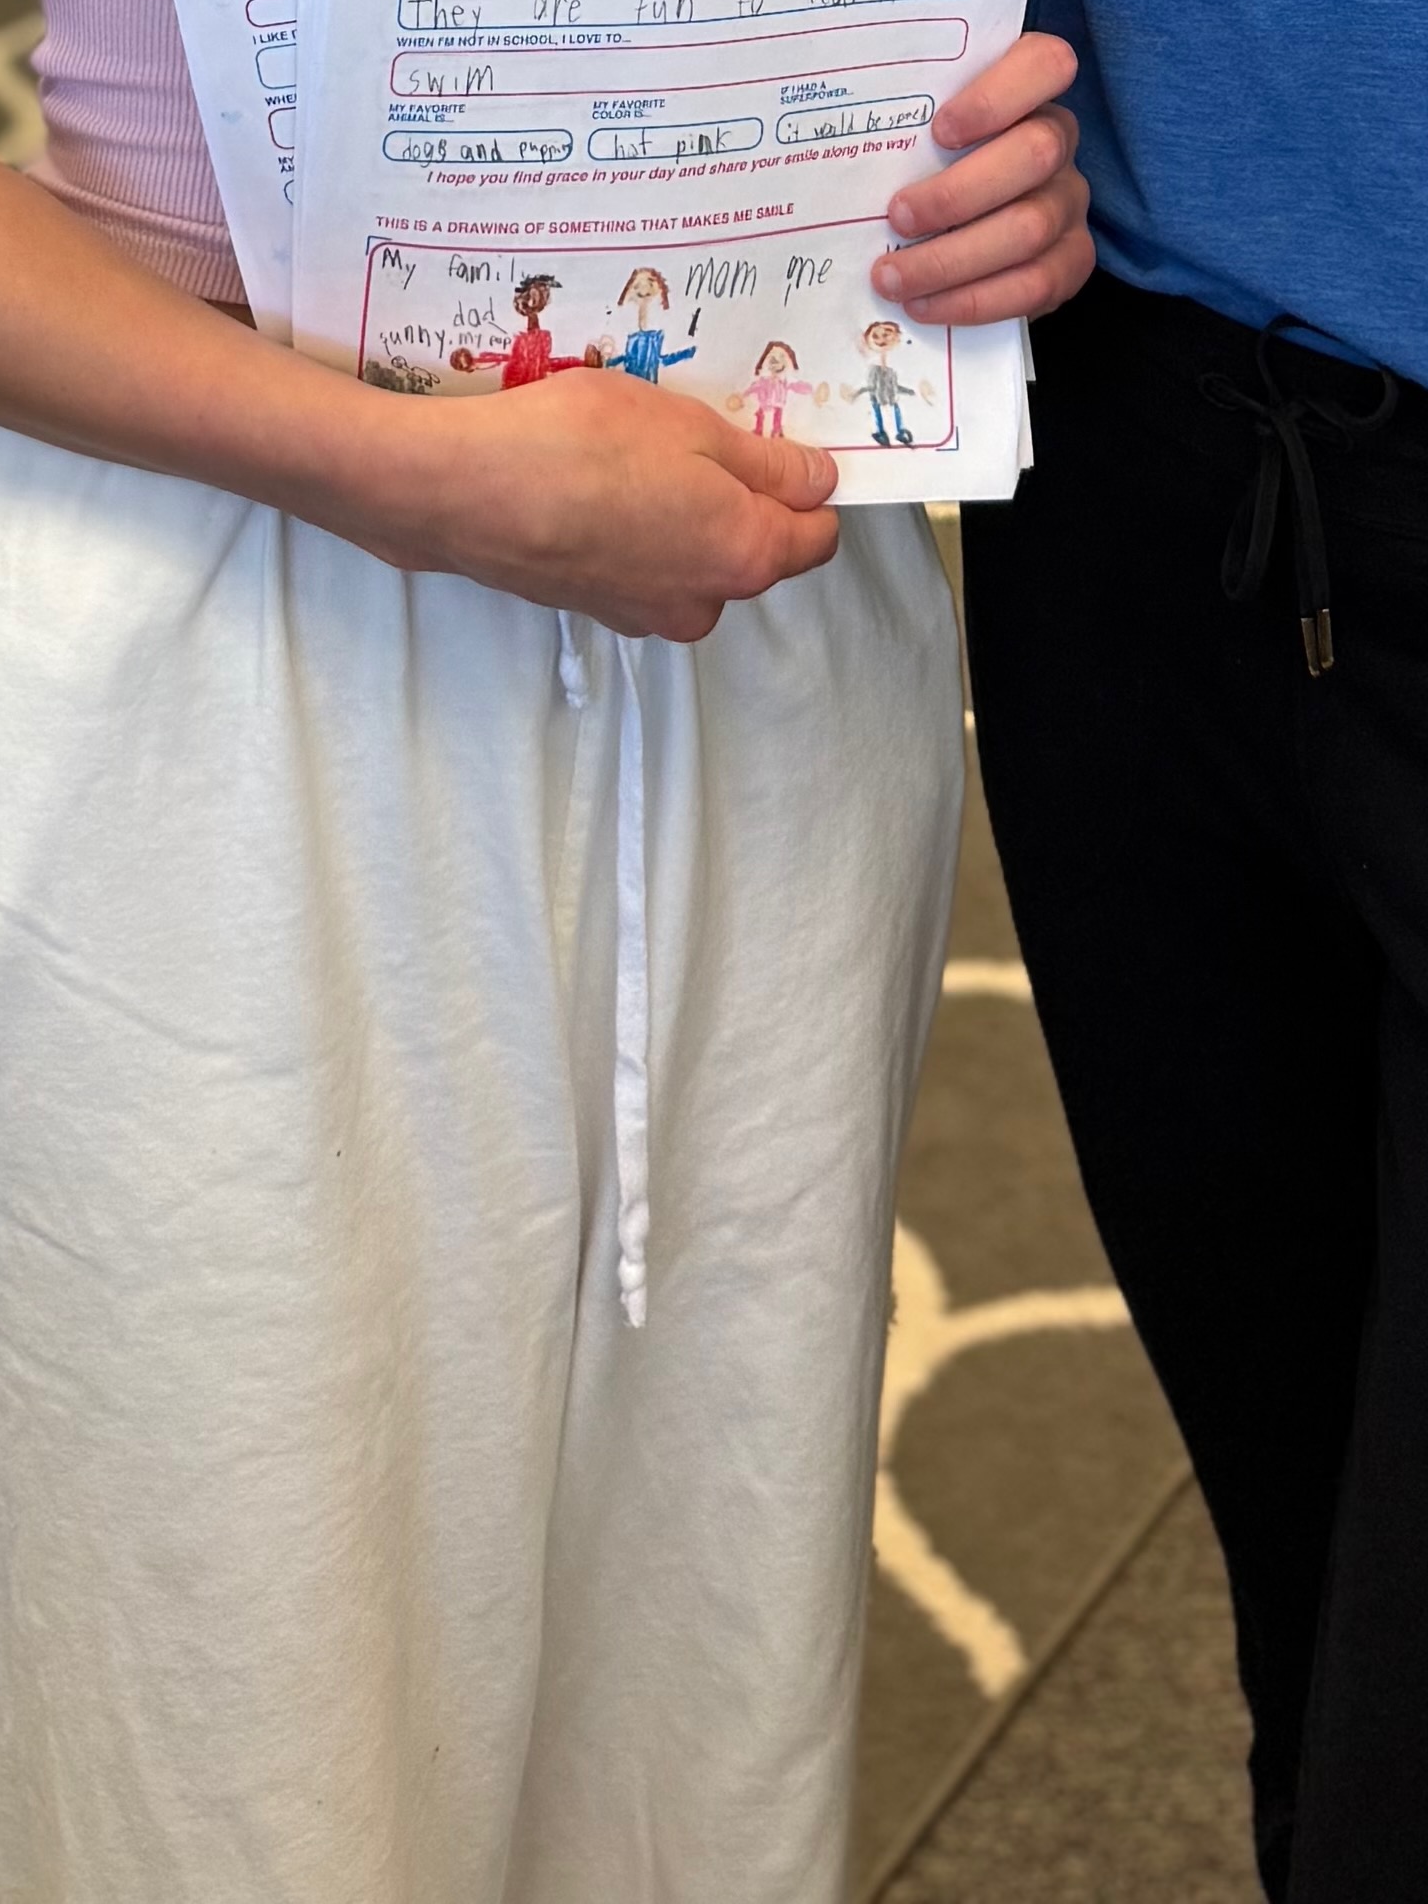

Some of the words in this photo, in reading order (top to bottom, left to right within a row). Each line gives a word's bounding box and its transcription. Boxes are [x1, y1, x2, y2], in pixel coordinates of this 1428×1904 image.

[253, 35, 257, 45] I
[259, 30, 288, 44] LIKE
[396, 36, 434, 47] WHEN
[457, 35, 484, 47] NOT
[487, 35, 500, 46] IN
[503, 34, 559, 47] SCHOOL,
[569, 33, 602, 44] LOVE
[821, 81, 827, 90] A
[388, 104, 407, 114] MY
[409, 103, 466, 114] FAVORITE
[593, 100, 610, 110] MY
[612, 98, 666, 110] FAVORITE
[387, 113, 431, 123] ANIMAL
[592, 109, 631, 120] COLOR
[460, 138, 504, 163] and
[427, 172, 433, 183] I
[436, 170, 474, 187] hope
[479, 172, 509, 188] you
[512, 170, 543, 184] find
[545, 171, 589, 187] grace
[592, 169, 606, 181] in
[611, 170, 646, 185] your
[648, 167, 676, 183] day
[678, 163, 706, 178] and
[709, 159, 748, 176] share
[750, 155, 782, 173] your
[785, 148, 820, 165] smile
[822, 145, 860, 163] along
[862, 140, 883, 154] the
[885, 135, 918, 153] way!
[376, 215, 410, 230] THIS
[413, 219, 428, 232] IS
[432, 220, 443, 232] A
[447, 221, 519, 235] DRAWING
[524, 222, 544, 235] OF
[548, 219, 637, 234] SOMETHING
[640, 218, 678, 231] THAT
[681, 212, 730, 229] MAKES
[733, 209, 752, 223] ME
[756, 202, 795, 220] SMILE
[382, 247, 417, 290] My
[453, 296, 496, 328] dad
